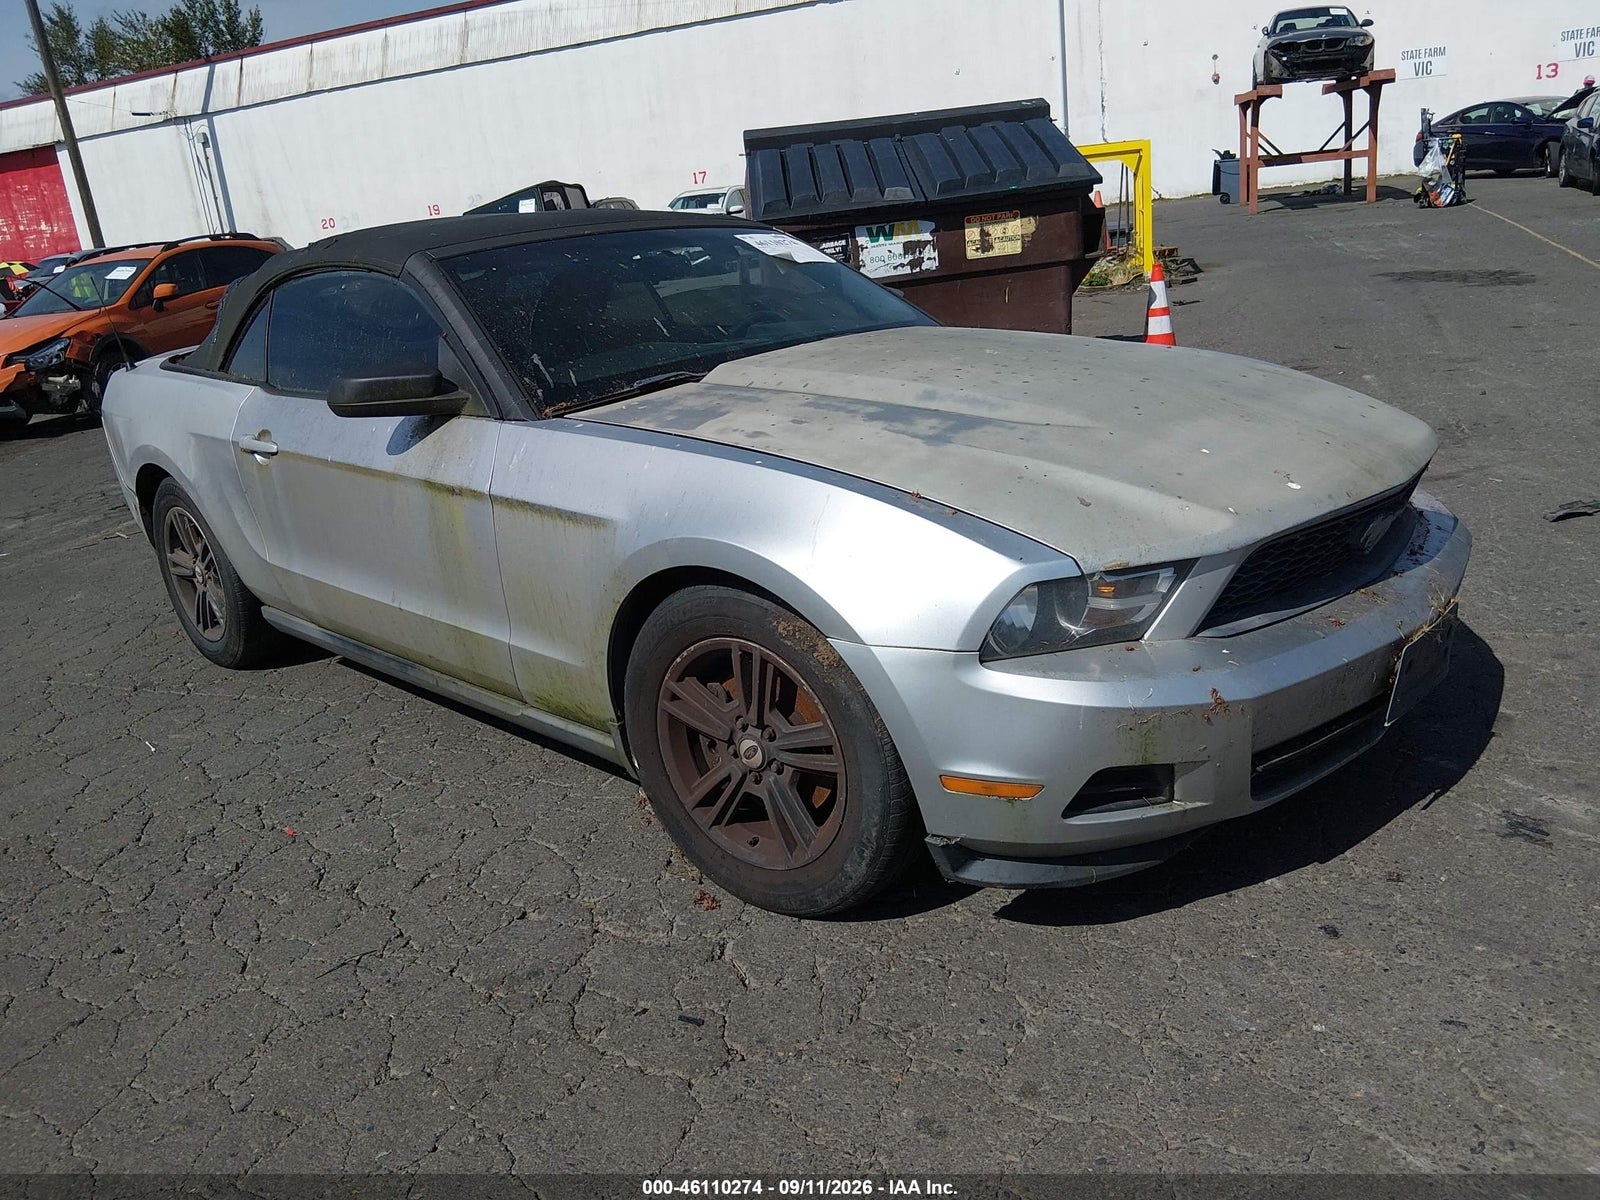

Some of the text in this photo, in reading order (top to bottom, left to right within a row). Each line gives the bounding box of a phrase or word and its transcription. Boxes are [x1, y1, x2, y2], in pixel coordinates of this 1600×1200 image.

[1560, 28, 1584, 41] STATE
[1401, 46, 1446, 61] STATE FARM
[1574, 40, 1595, 58] VIC
[1413, 60, 1432, 76] VIC
[1536, 62, 1559, 79] 13
[693, 171, 707, 184] 17
[428, 204, 440, 216] 19
[321, 217, 336, 230] 20
[865, 220, 921, 243] WM
